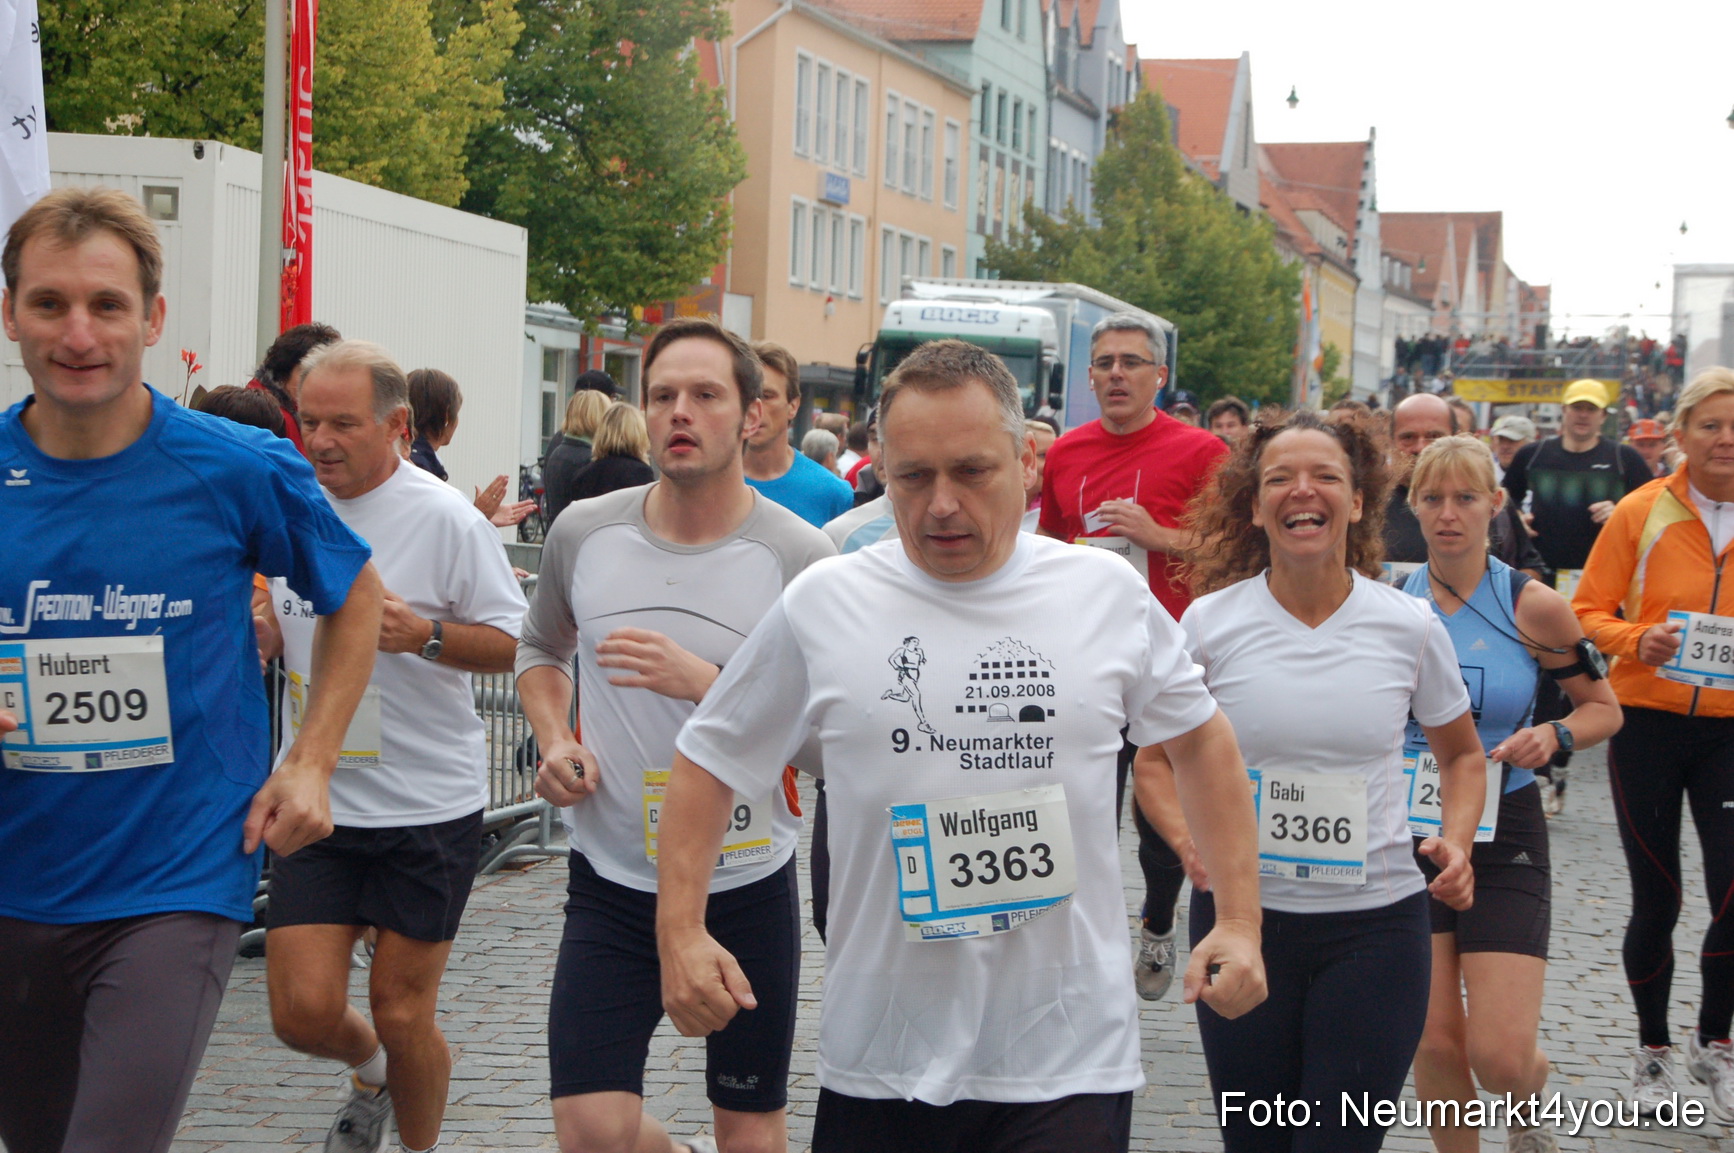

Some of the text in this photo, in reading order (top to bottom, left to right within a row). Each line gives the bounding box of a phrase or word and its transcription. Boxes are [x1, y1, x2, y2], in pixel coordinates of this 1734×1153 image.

[1507, 383, 1563, 397] START
[1694, 620, 1733, 637] Andrea
[1690, 641, 1734, 664] 318
[39, 653, 111, 676] Hubert
[5, 691, 15, 708] C
[965, 684, 1056, 699] 21.09.2008
[45, 688, 148, 725] 2509
[891, 728, 1054, 754] 9. Neumarkter
[104, 745, 169, 760] PFLEIDERER
[960, 752, 1054, 770] Stadtlauf
[1270, 780, 1304, 802] Gabi
[650, 809, 658, 823] C
[726, 804, 751, 832] 9
[939, 808, 1038, 837] Wolfgang
[1270, 813, 1351, 845] 3366
[725, 845, 771, 860] PFLEIDERER
[907, 856, 917, 874] D
[949, 842, 1054, 888] 3363
[1311, 866, 1362, 877] PFLEIDERER
[921, 922, 966, 936] BOCK
